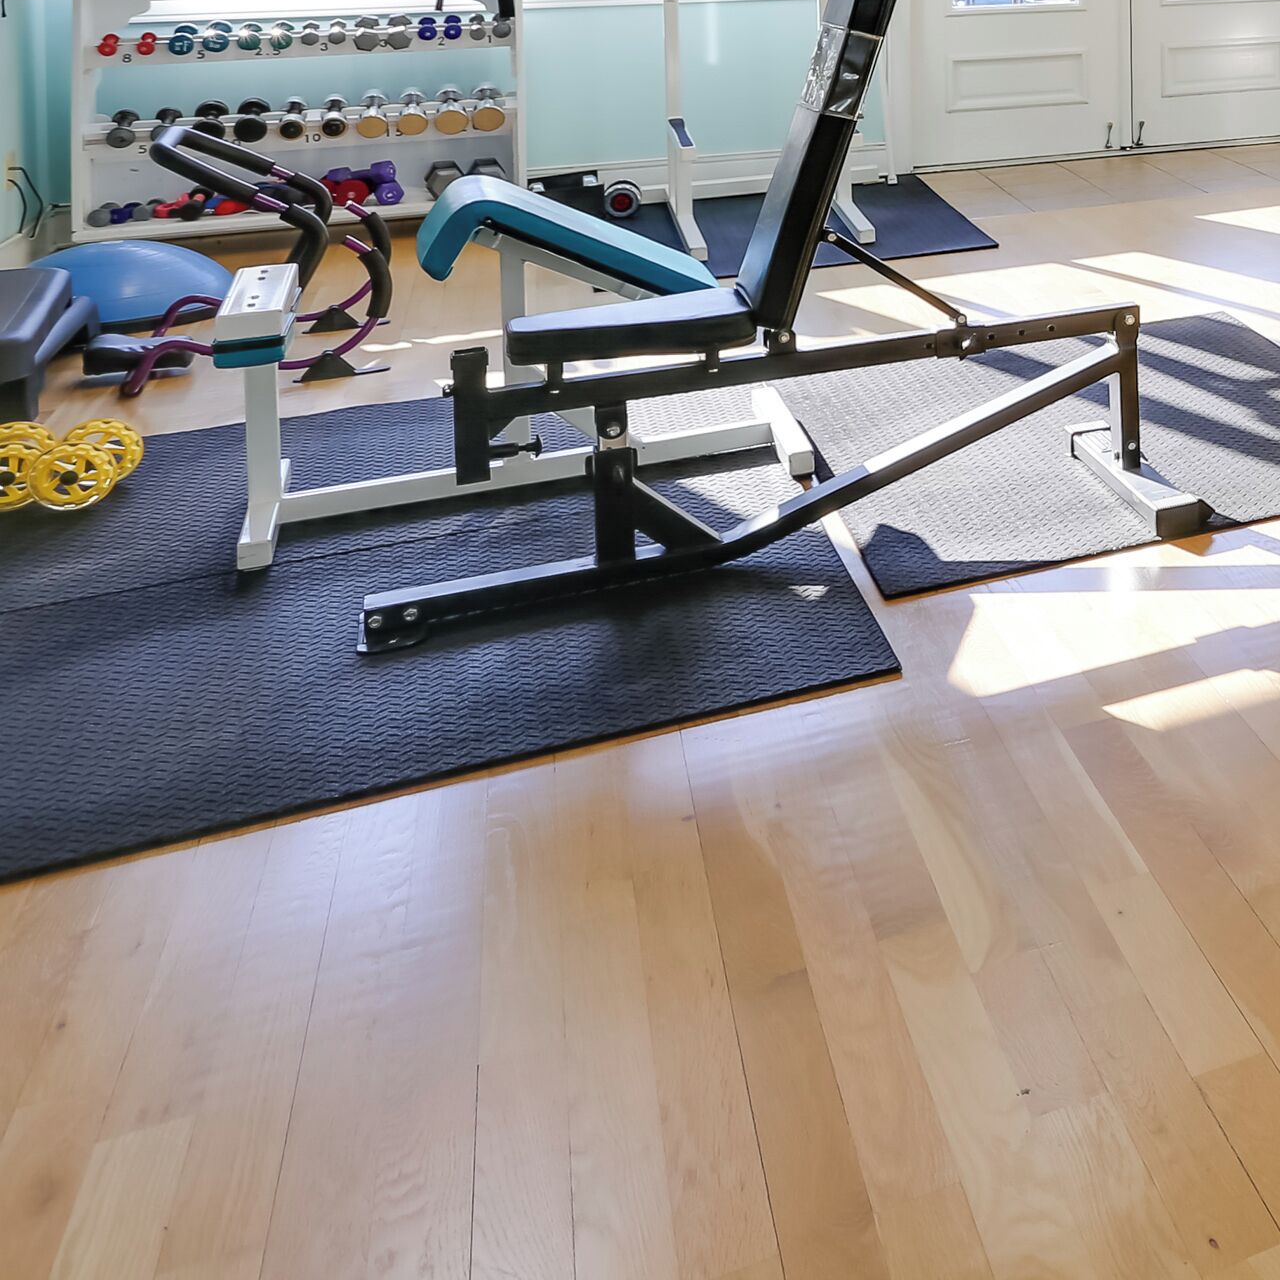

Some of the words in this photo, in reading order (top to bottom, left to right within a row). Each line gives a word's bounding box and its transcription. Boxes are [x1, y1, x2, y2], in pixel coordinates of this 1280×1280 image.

[122, 53, 132, 63] 8
[197, 49, 205, 60] 5
[320, 42, 328, 51] 3
[438, 37, 445, 46] 2
[487, 35, 492, 44] 1
[138, 144, 147, 154] 5
[305, 133, 321, 144] 10
